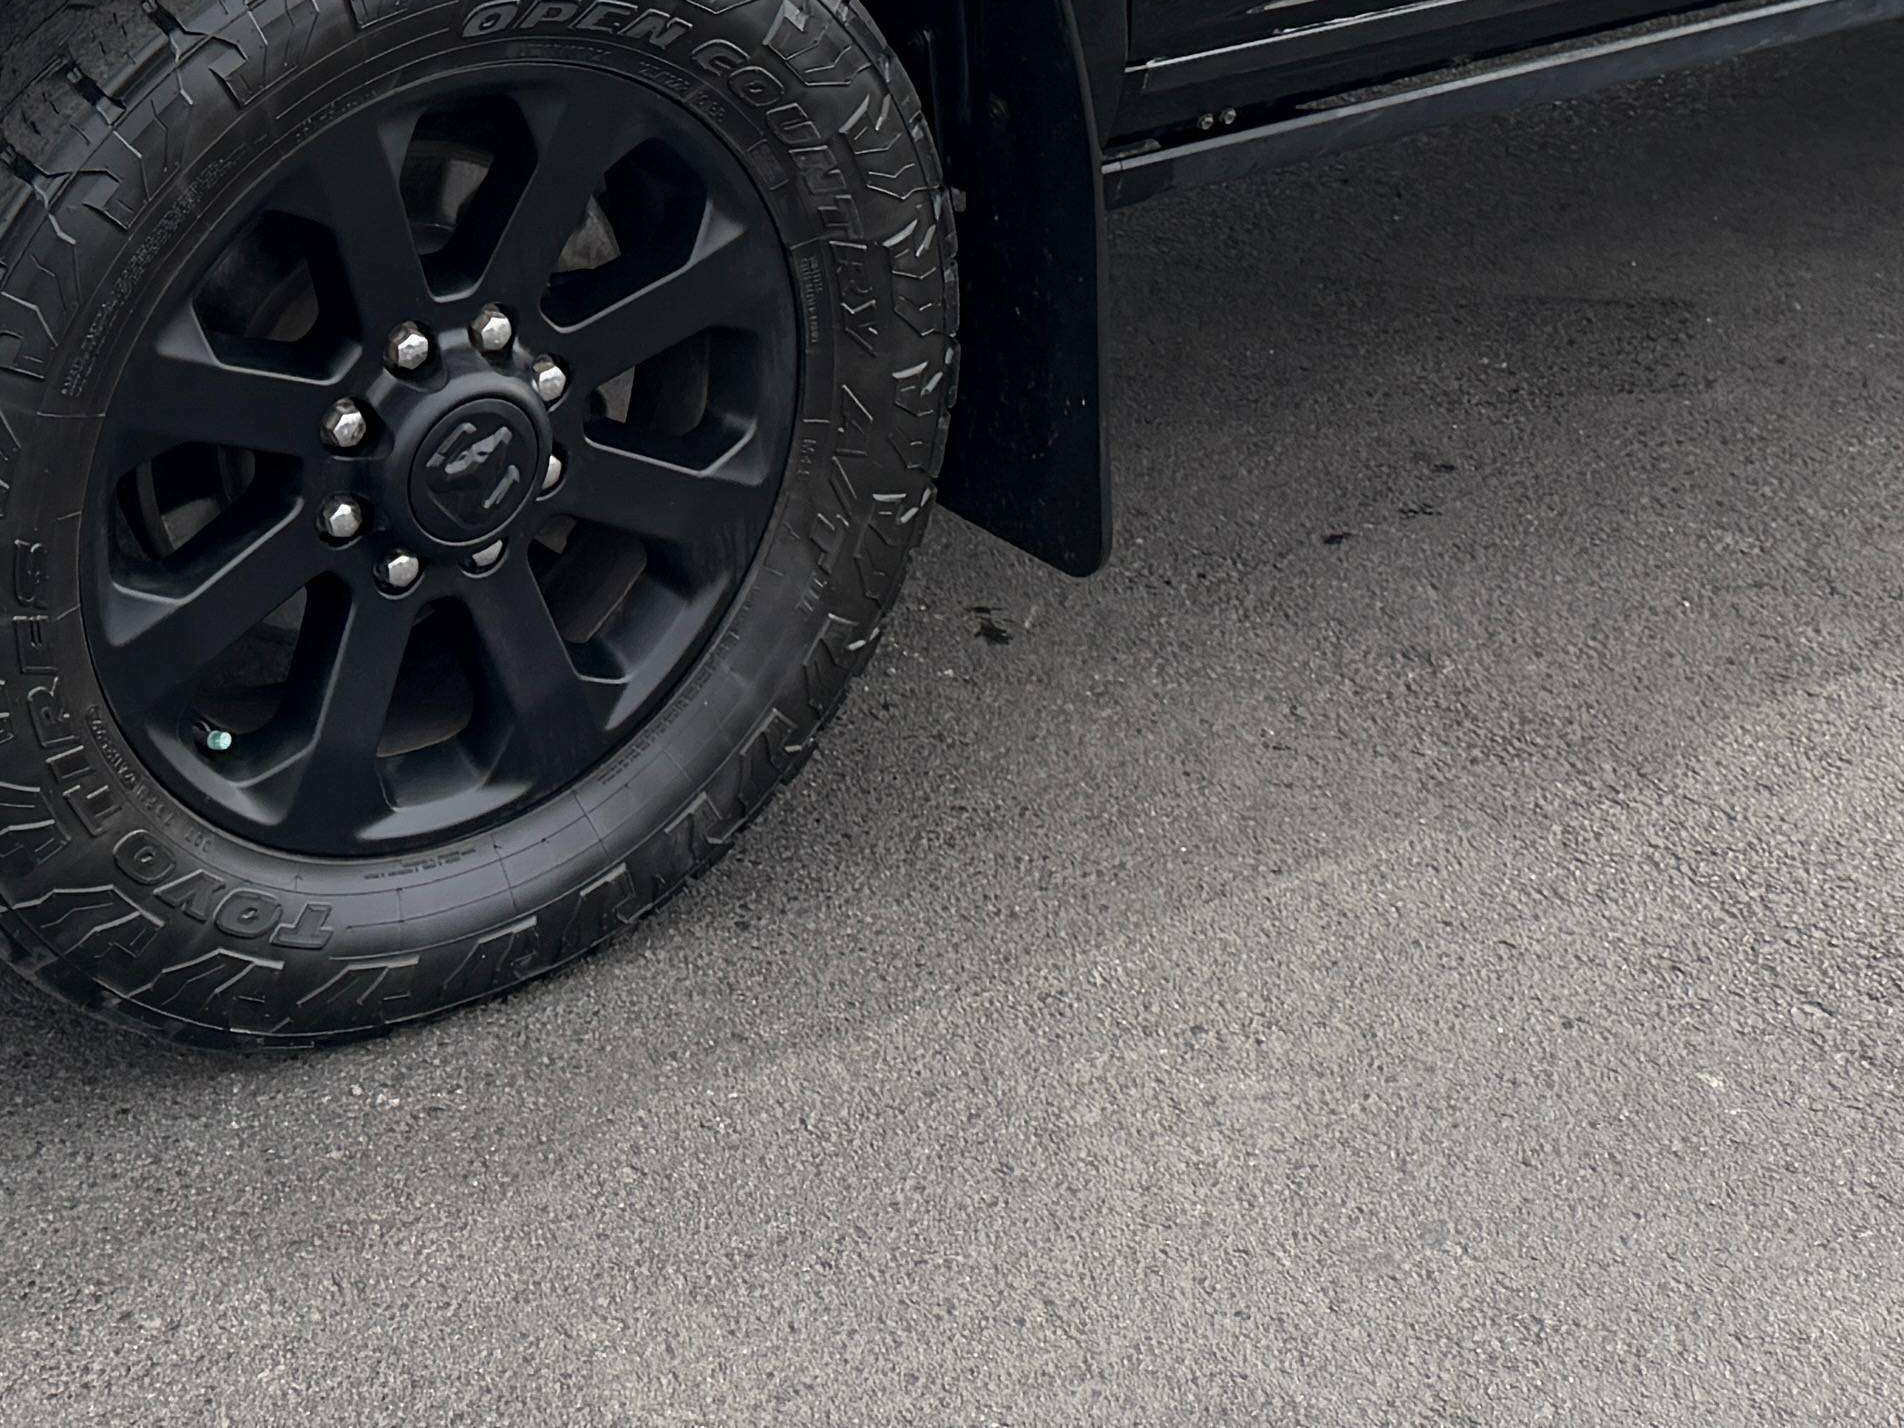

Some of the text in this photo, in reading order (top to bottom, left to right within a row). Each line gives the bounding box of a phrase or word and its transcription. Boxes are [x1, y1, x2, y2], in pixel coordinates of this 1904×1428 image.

[692, 39, 879, 357] COUNTRY
[11, 539, 122, 837] TIRES
[113, 829, 334, 949] TOYO
